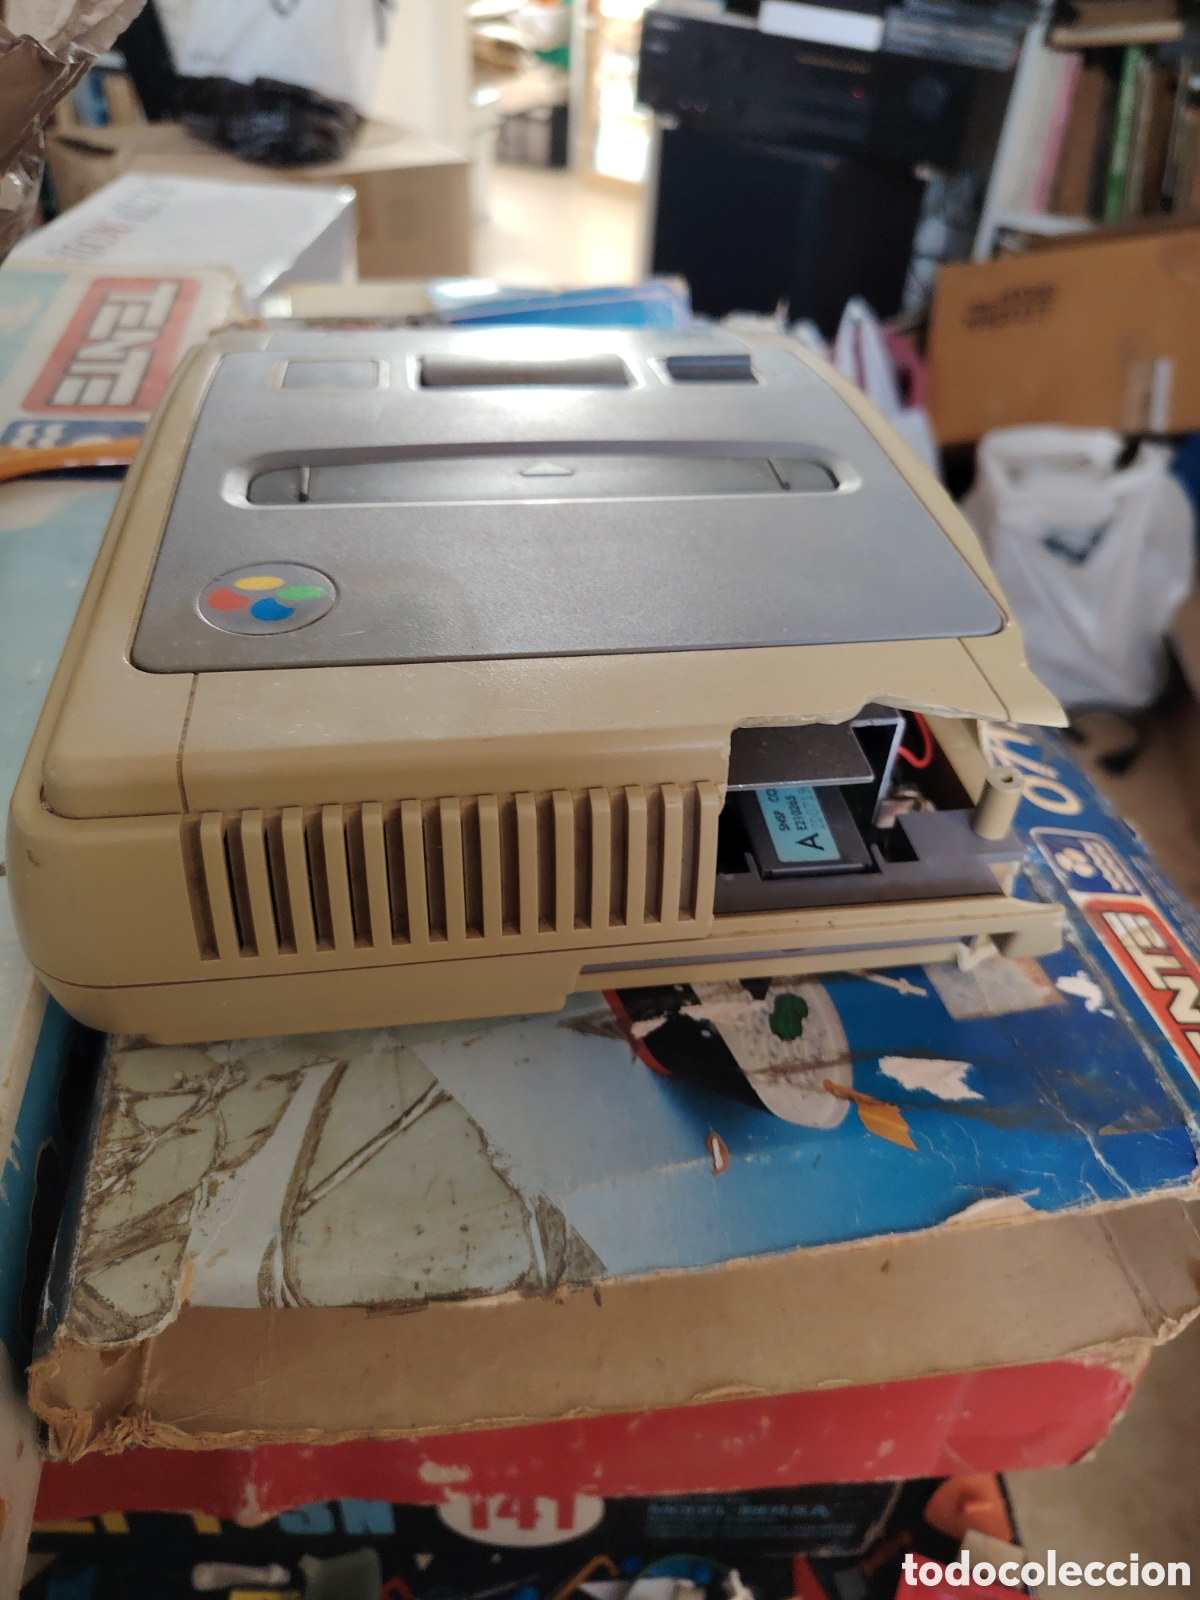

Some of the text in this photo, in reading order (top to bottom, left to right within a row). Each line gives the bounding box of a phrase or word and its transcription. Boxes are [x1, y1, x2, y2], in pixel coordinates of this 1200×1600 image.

[49, 281, 182, 406] TENTE
[796, 832, 825, 851] A
[1101, 911, 1200, 1058] NTE
